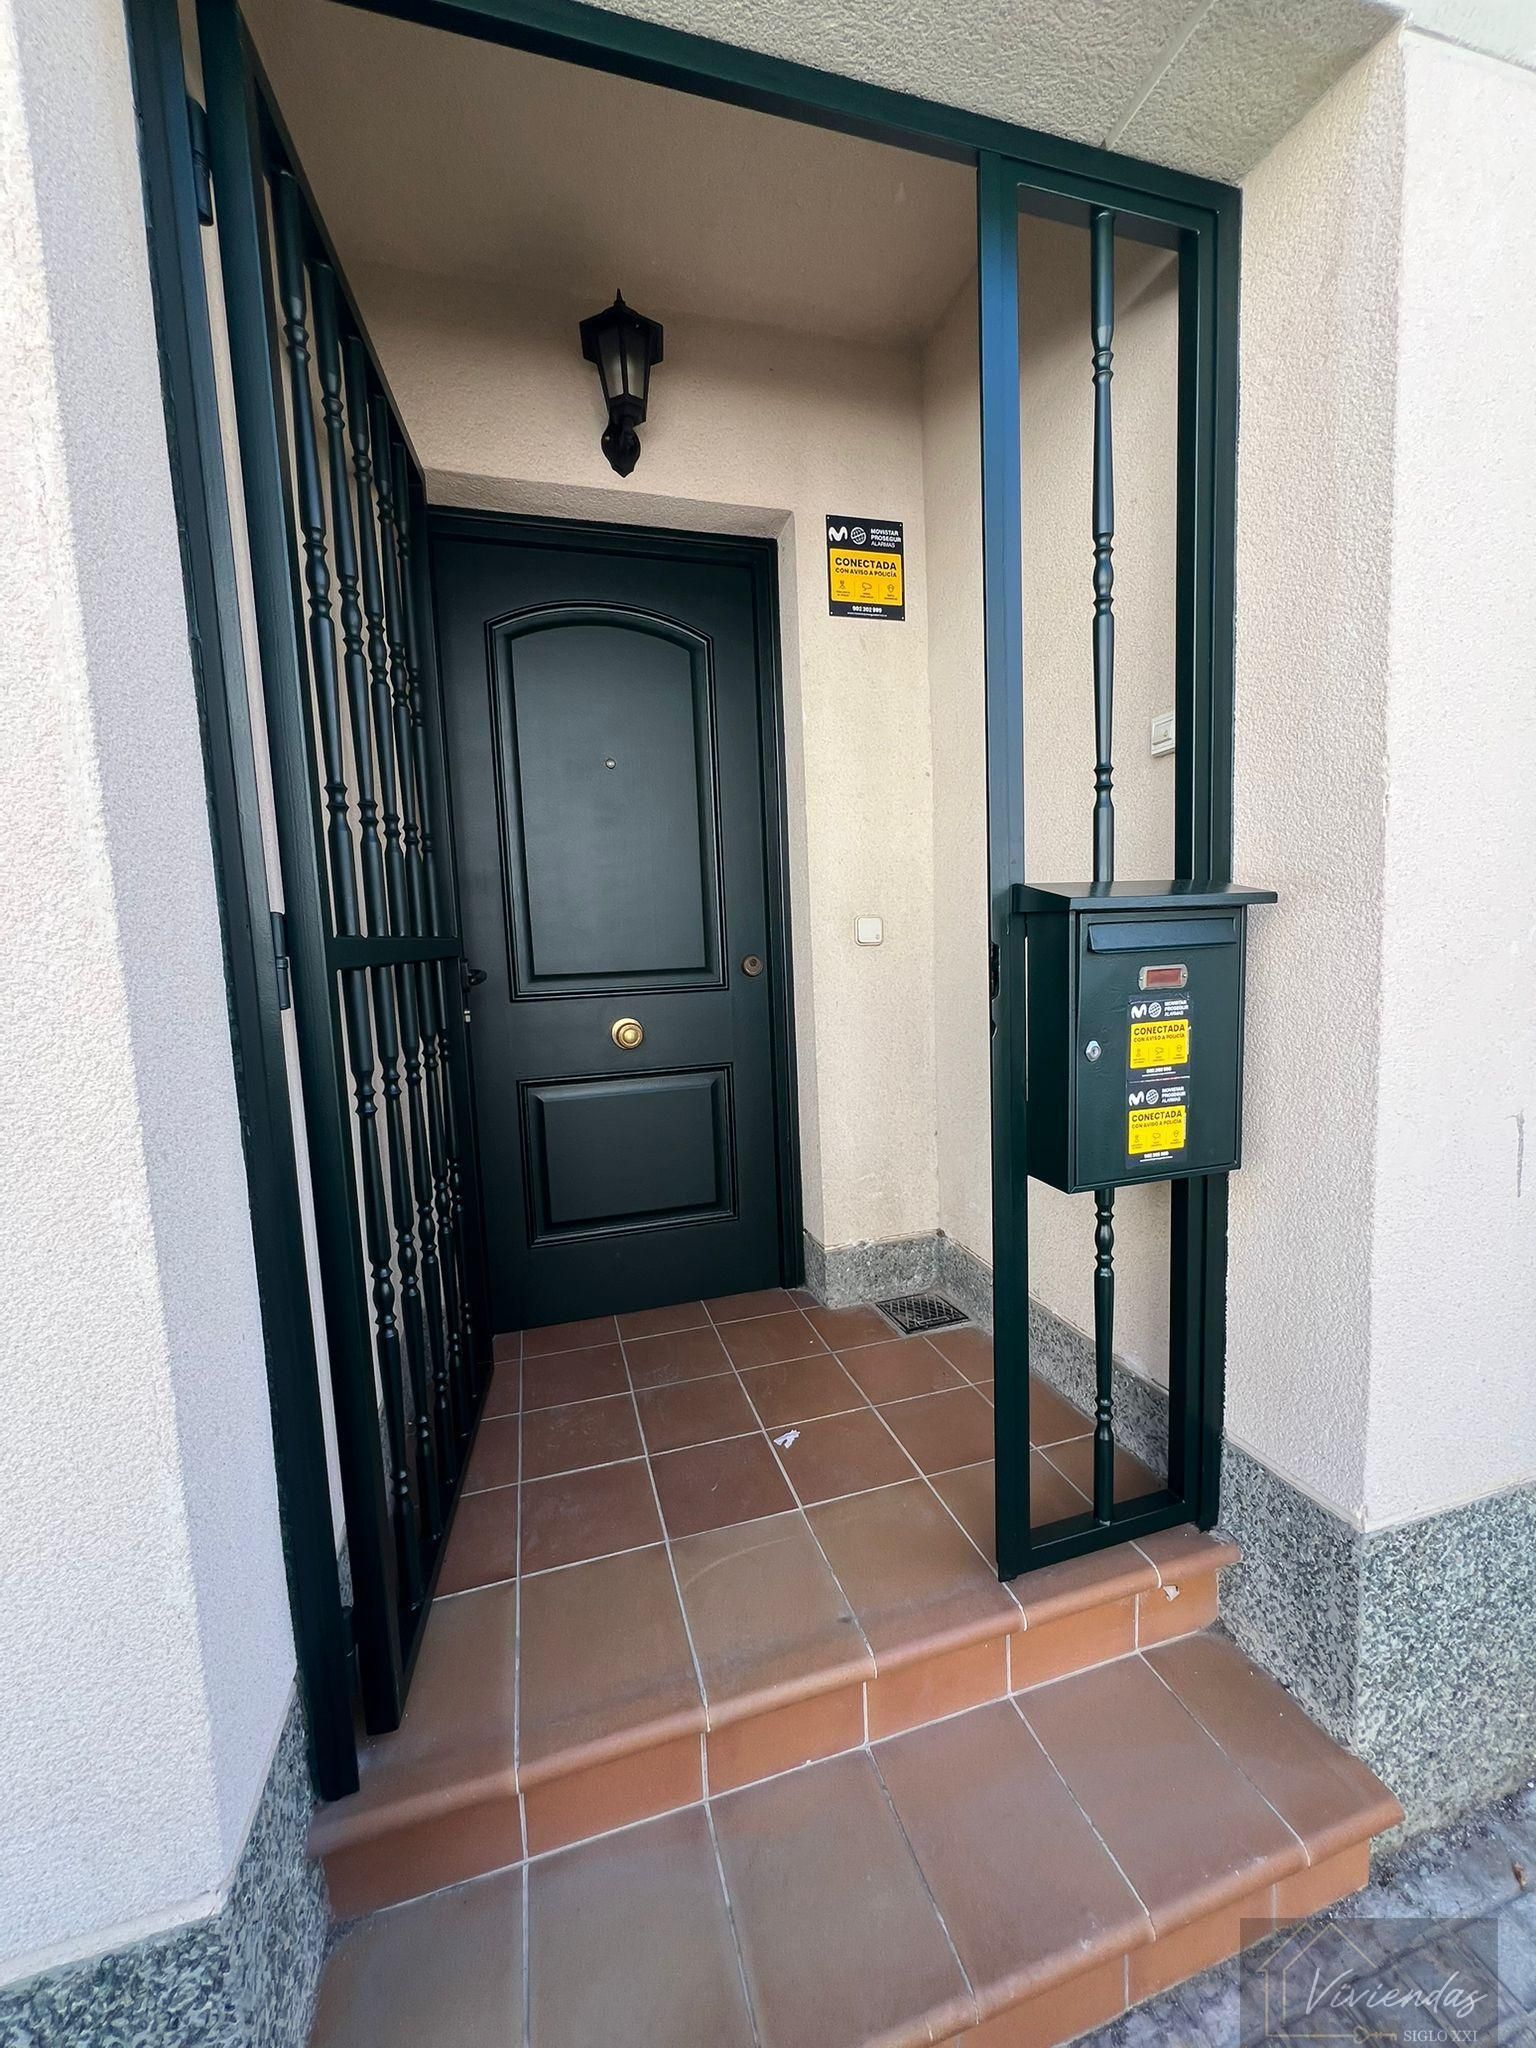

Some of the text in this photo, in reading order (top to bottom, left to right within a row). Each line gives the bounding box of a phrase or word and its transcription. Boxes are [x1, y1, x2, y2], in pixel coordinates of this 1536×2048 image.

[870, 528, 899, 536] MOVISTAR
[870, 534, 902, 543] PROSEGUR
[835, 557, 897, 571] CONECTADA
[850, 568, 869, 576] AVISO
[874, 570, 897, 578] POLICÍA
[1133, 1024, 1185, 1036] CONECTADA
[1131, 1110, 1183, 1123] CONECTADA
